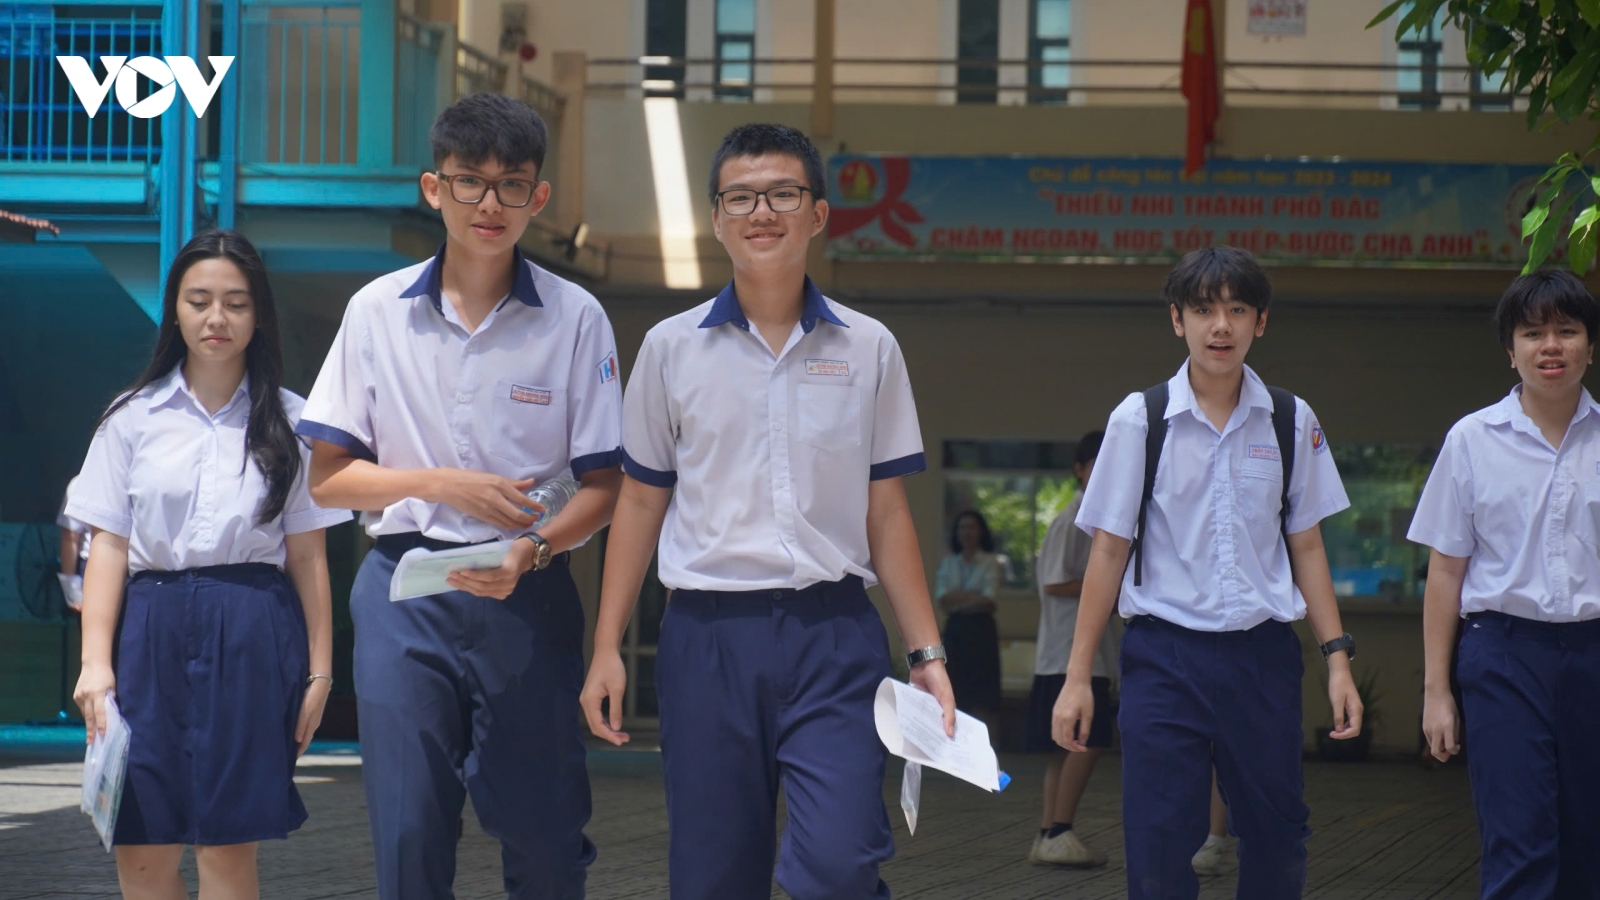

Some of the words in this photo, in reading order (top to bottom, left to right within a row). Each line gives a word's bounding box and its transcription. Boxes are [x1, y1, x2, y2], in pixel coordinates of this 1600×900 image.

[1130, 194, 1174, 216] NHI
[1184, 190, 1264, 217] THÀNH
[1272, 189, 1323, 218] PHỐ
[1329, 194, 1380, 219] BÁC
[1112, 228, 1164, 254] HỌC
[1363, 232, 1412, 256] CHA
